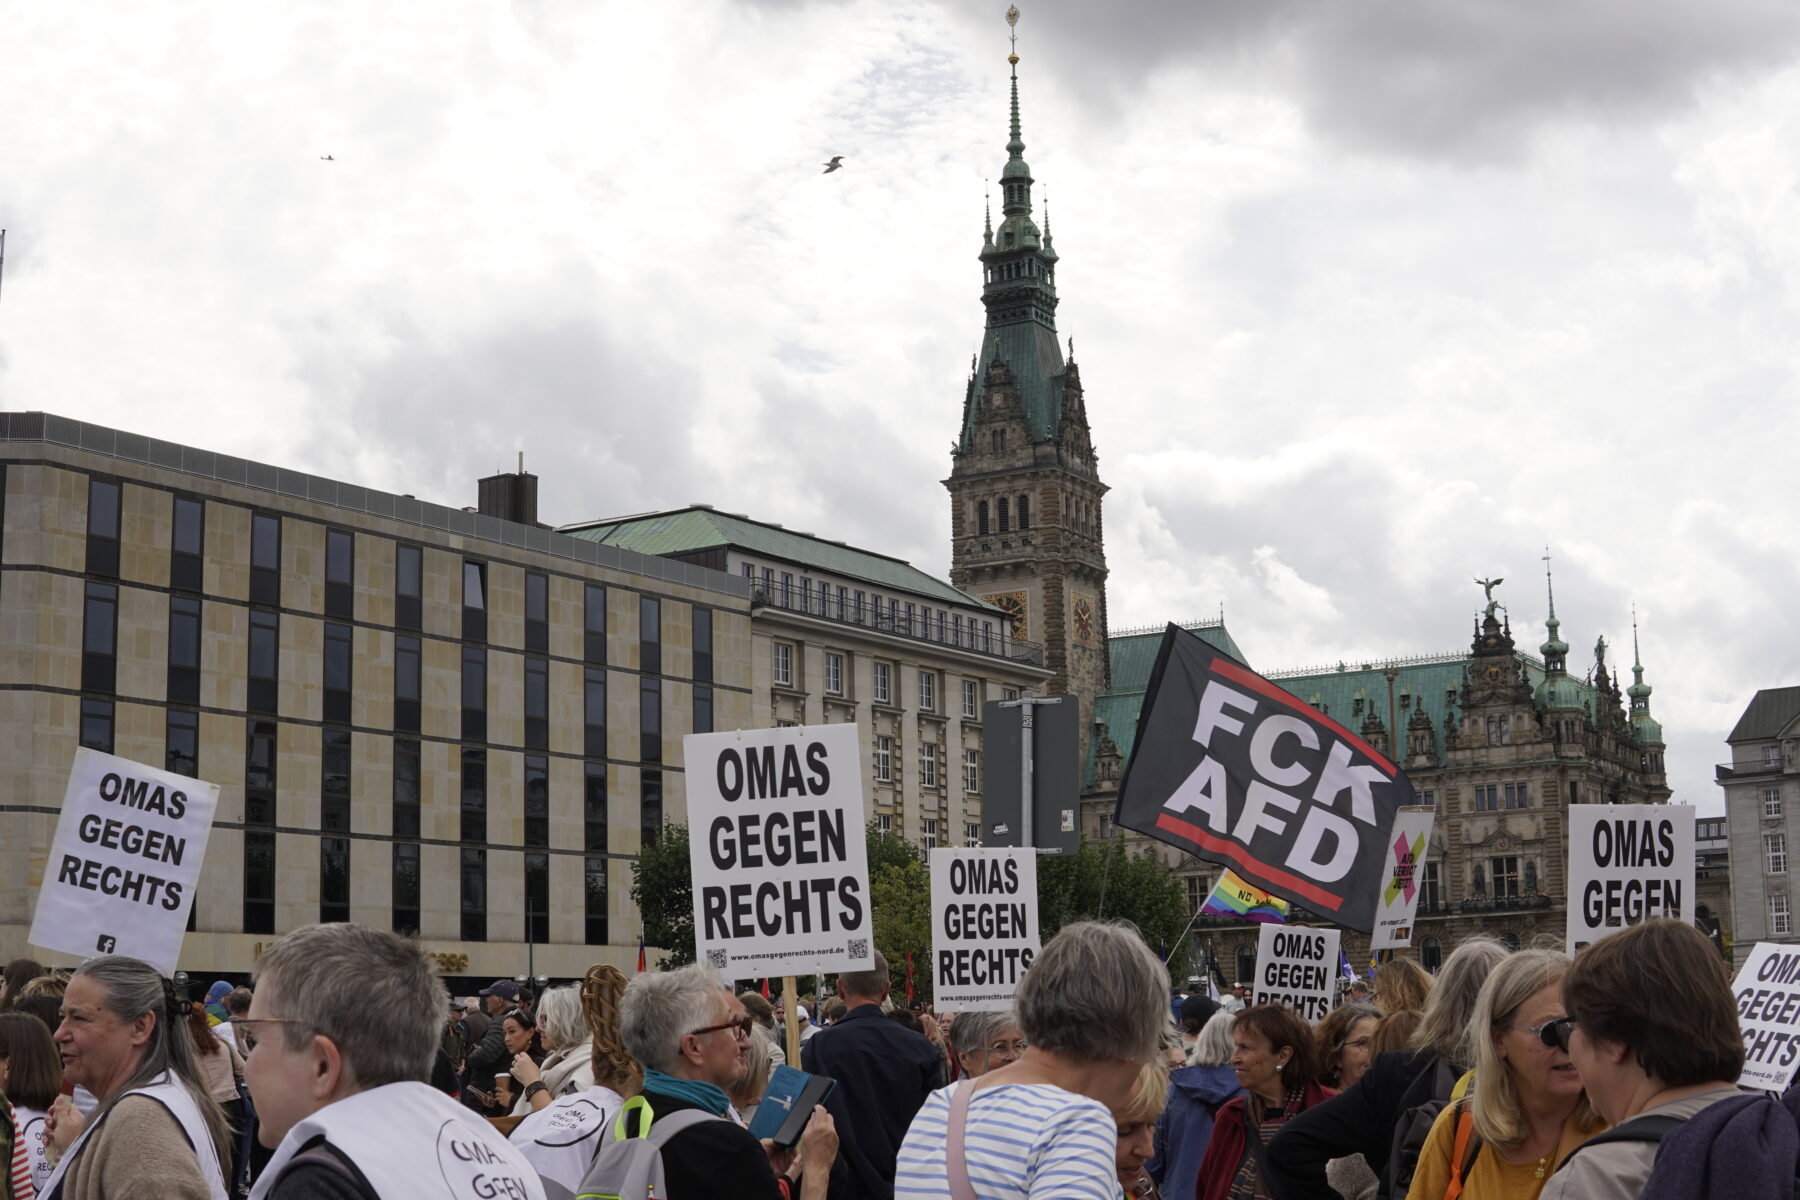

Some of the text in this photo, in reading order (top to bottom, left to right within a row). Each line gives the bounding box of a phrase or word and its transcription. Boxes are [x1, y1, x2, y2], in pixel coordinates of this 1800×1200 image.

[716, 741, 830, 802] OMAS
[1192, 680, 1392, 826] FCK
[99, 772, 188, 820] OMAS
[1163, 754, 1359, 883] AFD
[79, 814, 186, 866] GEGEN
[709, 808, 847, 871] GEGEN
[1592, 819, 1674, 868] OMAS
[58, 854, 183, 911] RECHTS
[950, 858, 1019, 895] OMAS
[702, 875, 863, 940] RECHTS
[944, 903, 1027, 940] GEGEN
[1583, 879, 1682, 928] GEGEN
[730, 947, 845, 961] www.omasgegenrechts-nord.de
[1273, 932, 1326, 961] OMAS
[1264, 962, 1328, 991] GEGEN
